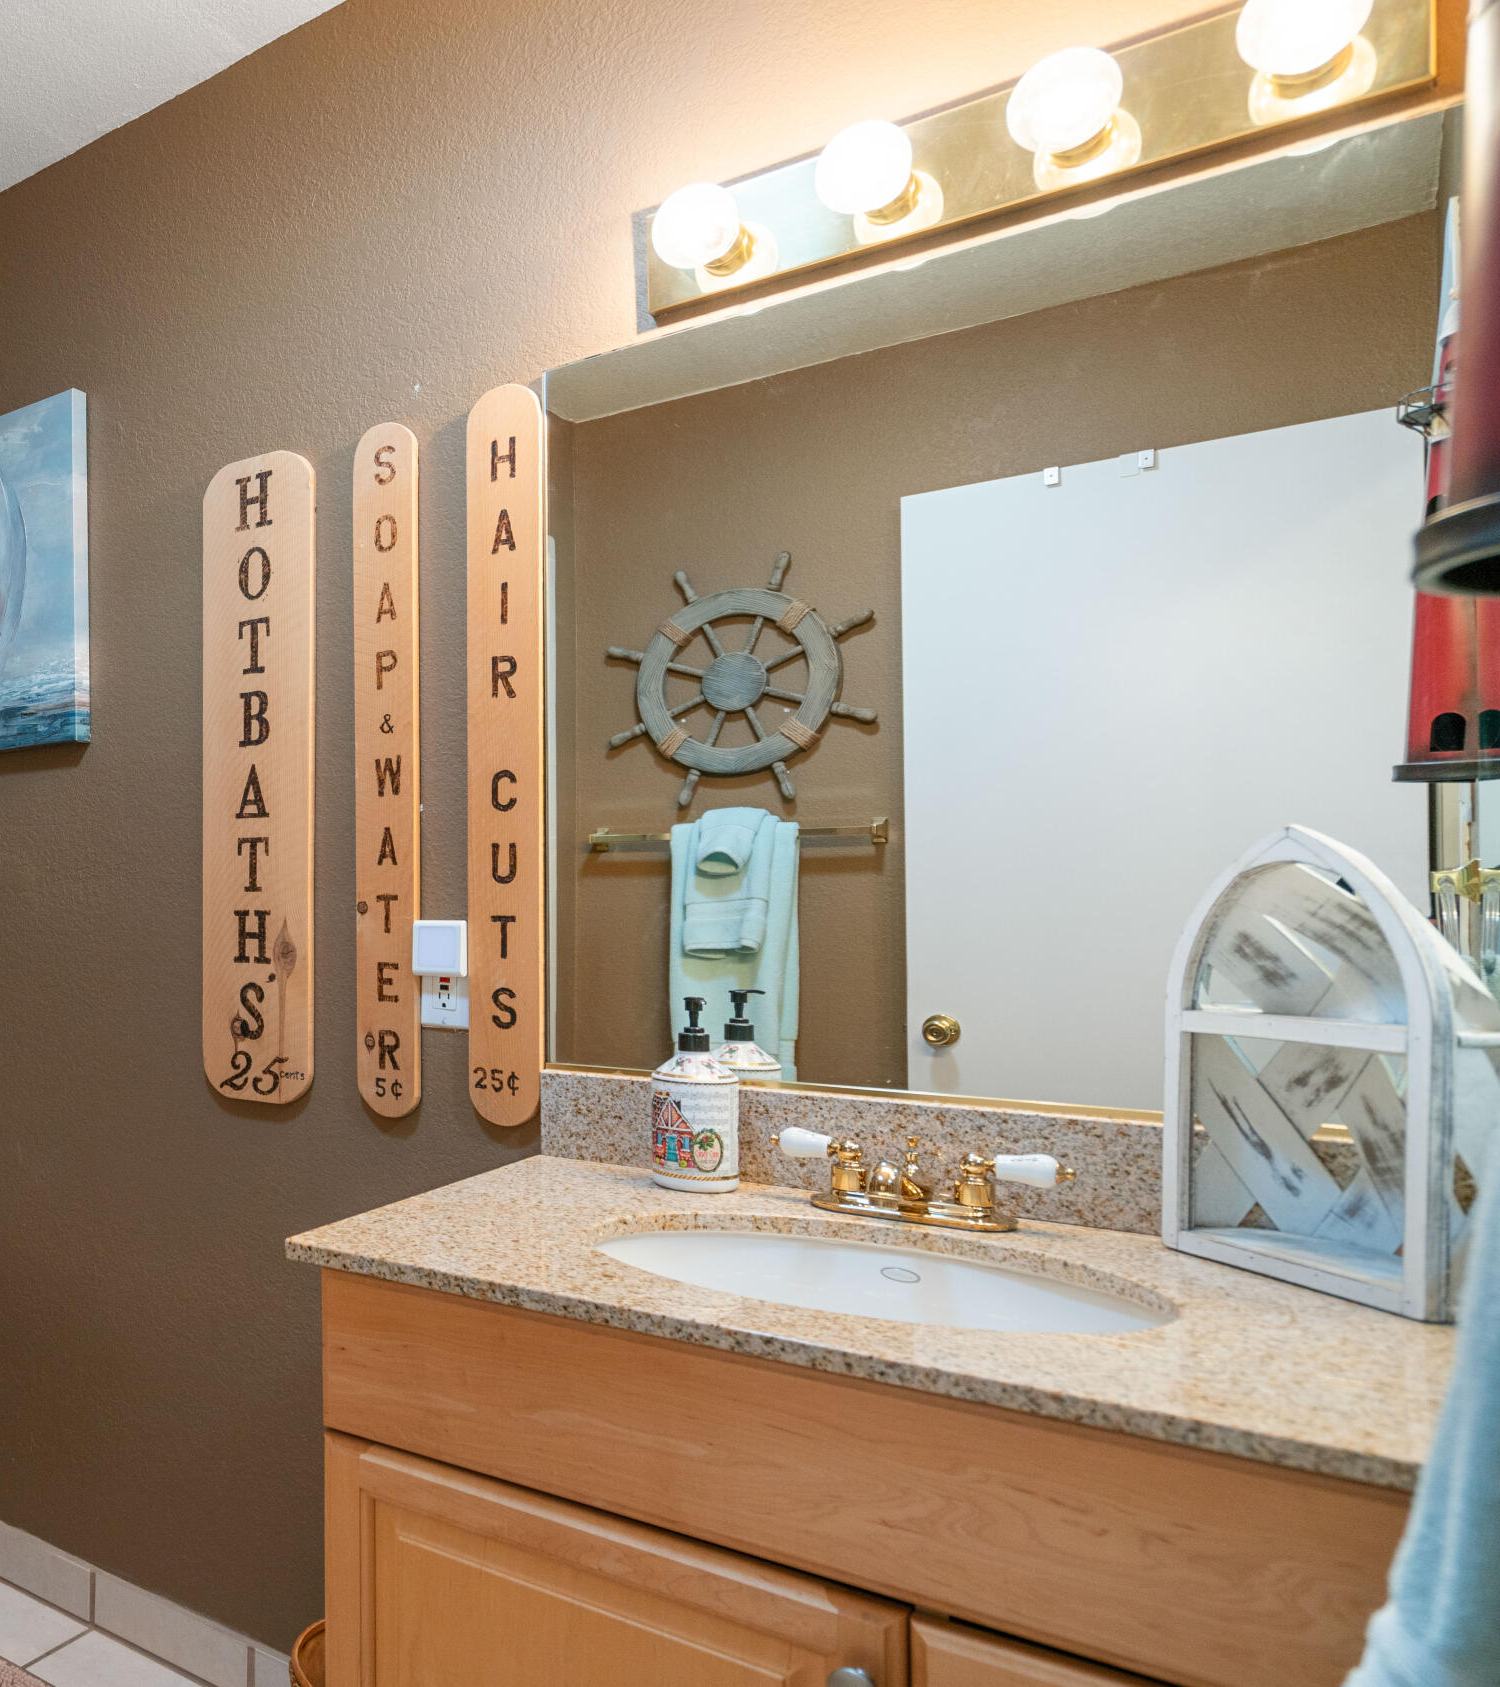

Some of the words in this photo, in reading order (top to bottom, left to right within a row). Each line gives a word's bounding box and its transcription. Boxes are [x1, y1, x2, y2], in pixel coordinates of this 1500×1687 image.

[490, 436, 518, 699] HAIR
[490, 769, 518, 1030] CUTS
[219, 1050, 289, 1096] 25
[280, 1070, 305, 1081] cents
[374, 1077, 403, 1100] 5¢
[473, 1066, 520, 1096] 25¢
